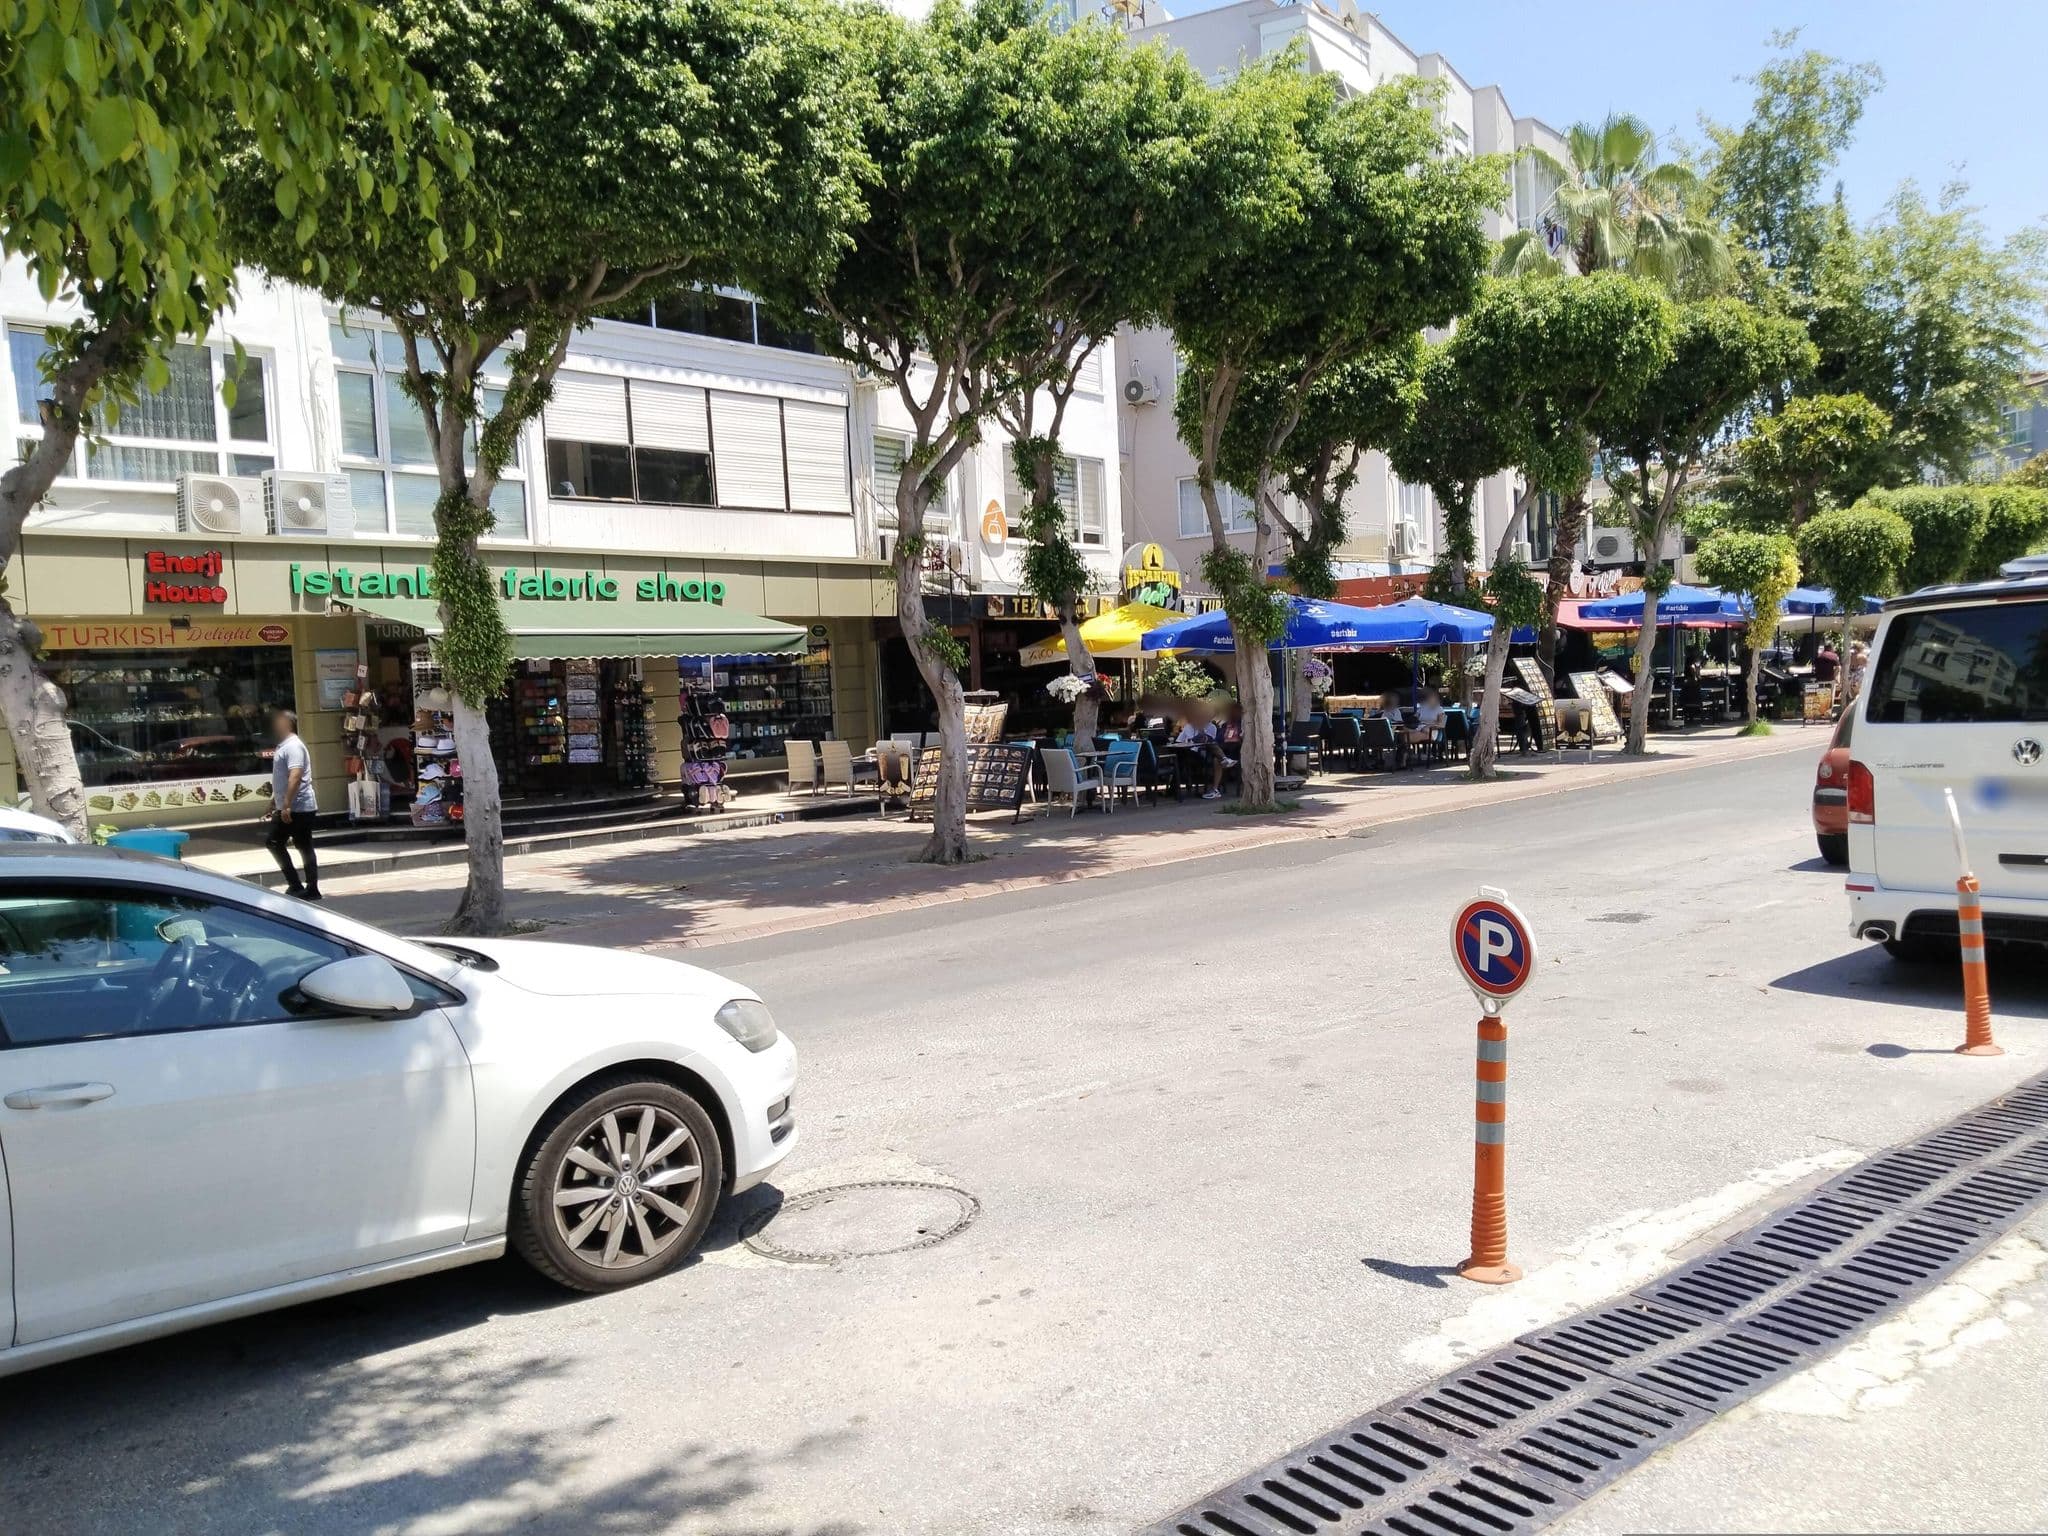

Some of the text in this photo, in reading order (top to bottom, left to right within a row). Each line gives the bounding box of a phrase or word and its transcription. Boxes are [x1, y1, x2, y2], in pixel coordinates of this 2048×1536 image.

[146, 552, 223, 578] Enerji
[146, 581, 228, 603] House
[290, 562, 727, 604] istanb fabric shop
[1012, 598, 1039, 614] TEX
[50, 626, 175, 647] TURKISH
[186, 626, 253, 645] Delight
[374, 624, 424, 640] TURKIS
[1479, 918, 1513, 973] P
